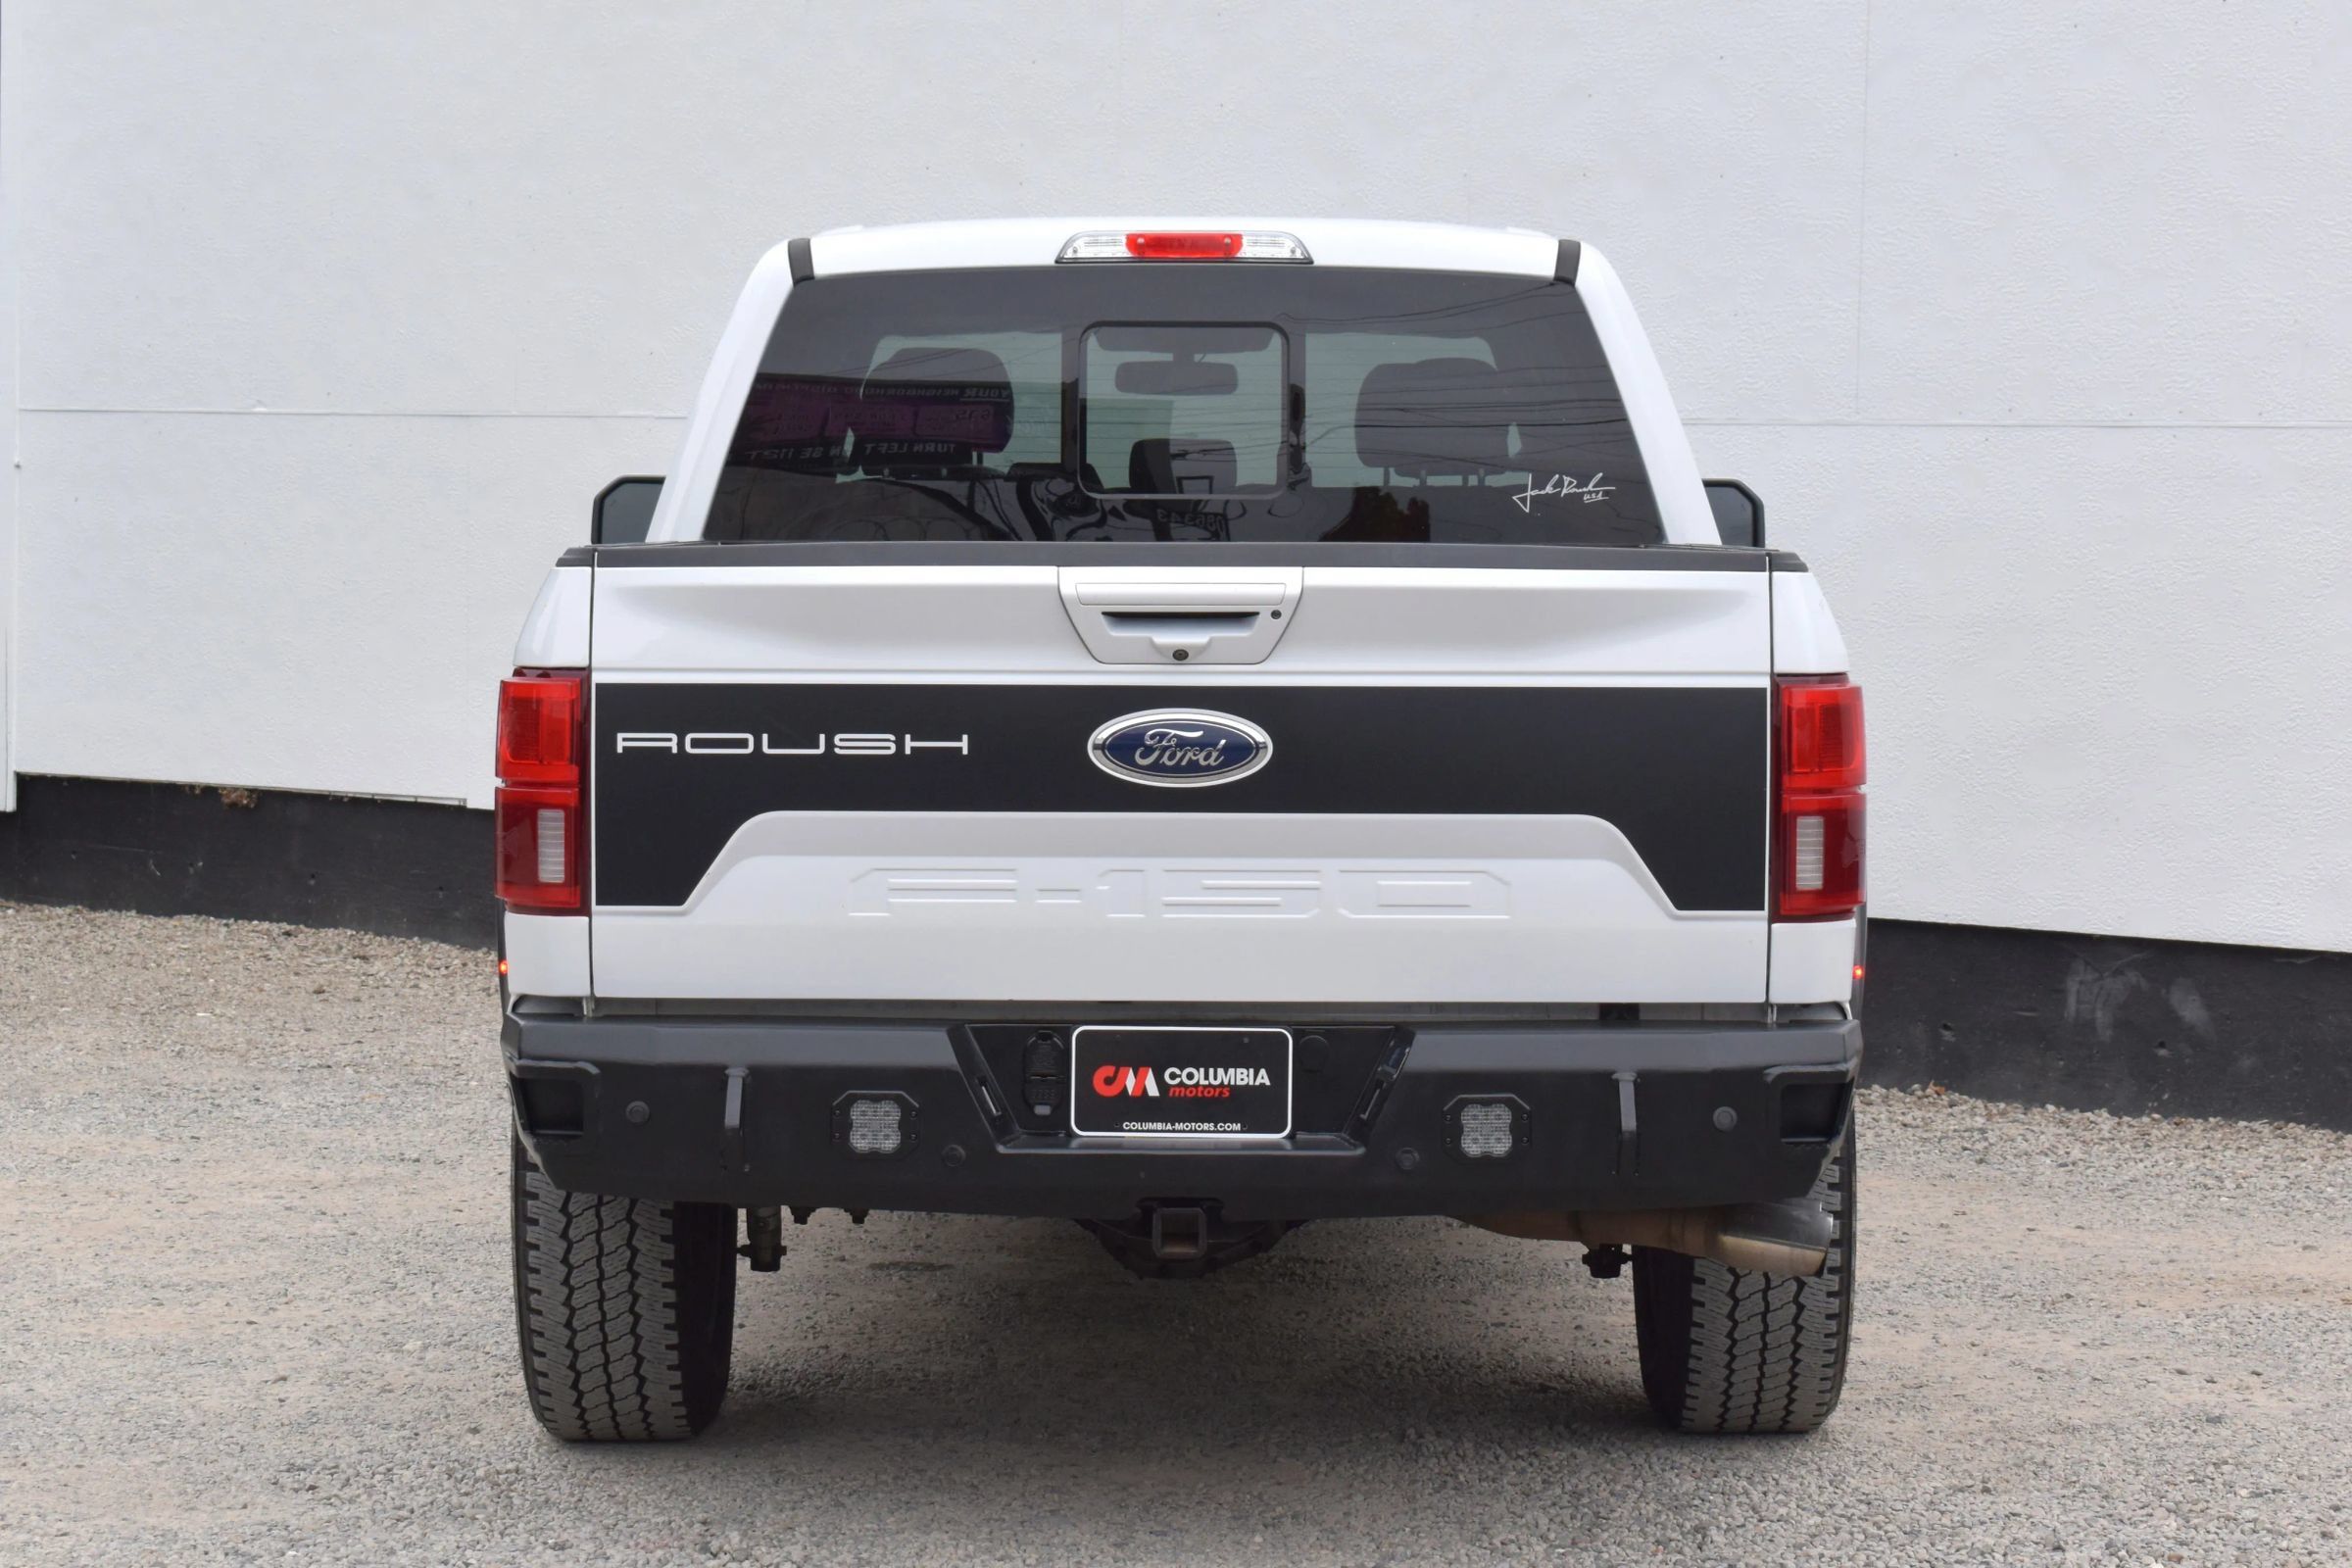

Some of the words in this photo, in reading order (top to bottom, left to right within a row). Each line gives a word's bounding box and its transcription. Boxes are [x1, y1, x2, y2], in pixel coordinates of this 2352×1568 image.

[616, 732, 969, 756] ROUSH
[1134, 728, 1225, 769] Ford
[848, 867, 1511, 919] F-150
[1163, 1066, 1271, 1087] COLUMBIA
[1168, 1085, 1231, 1099] motors
[1122, 1121, 1242, 1132] COLUMBIA-MOTORS.COM
